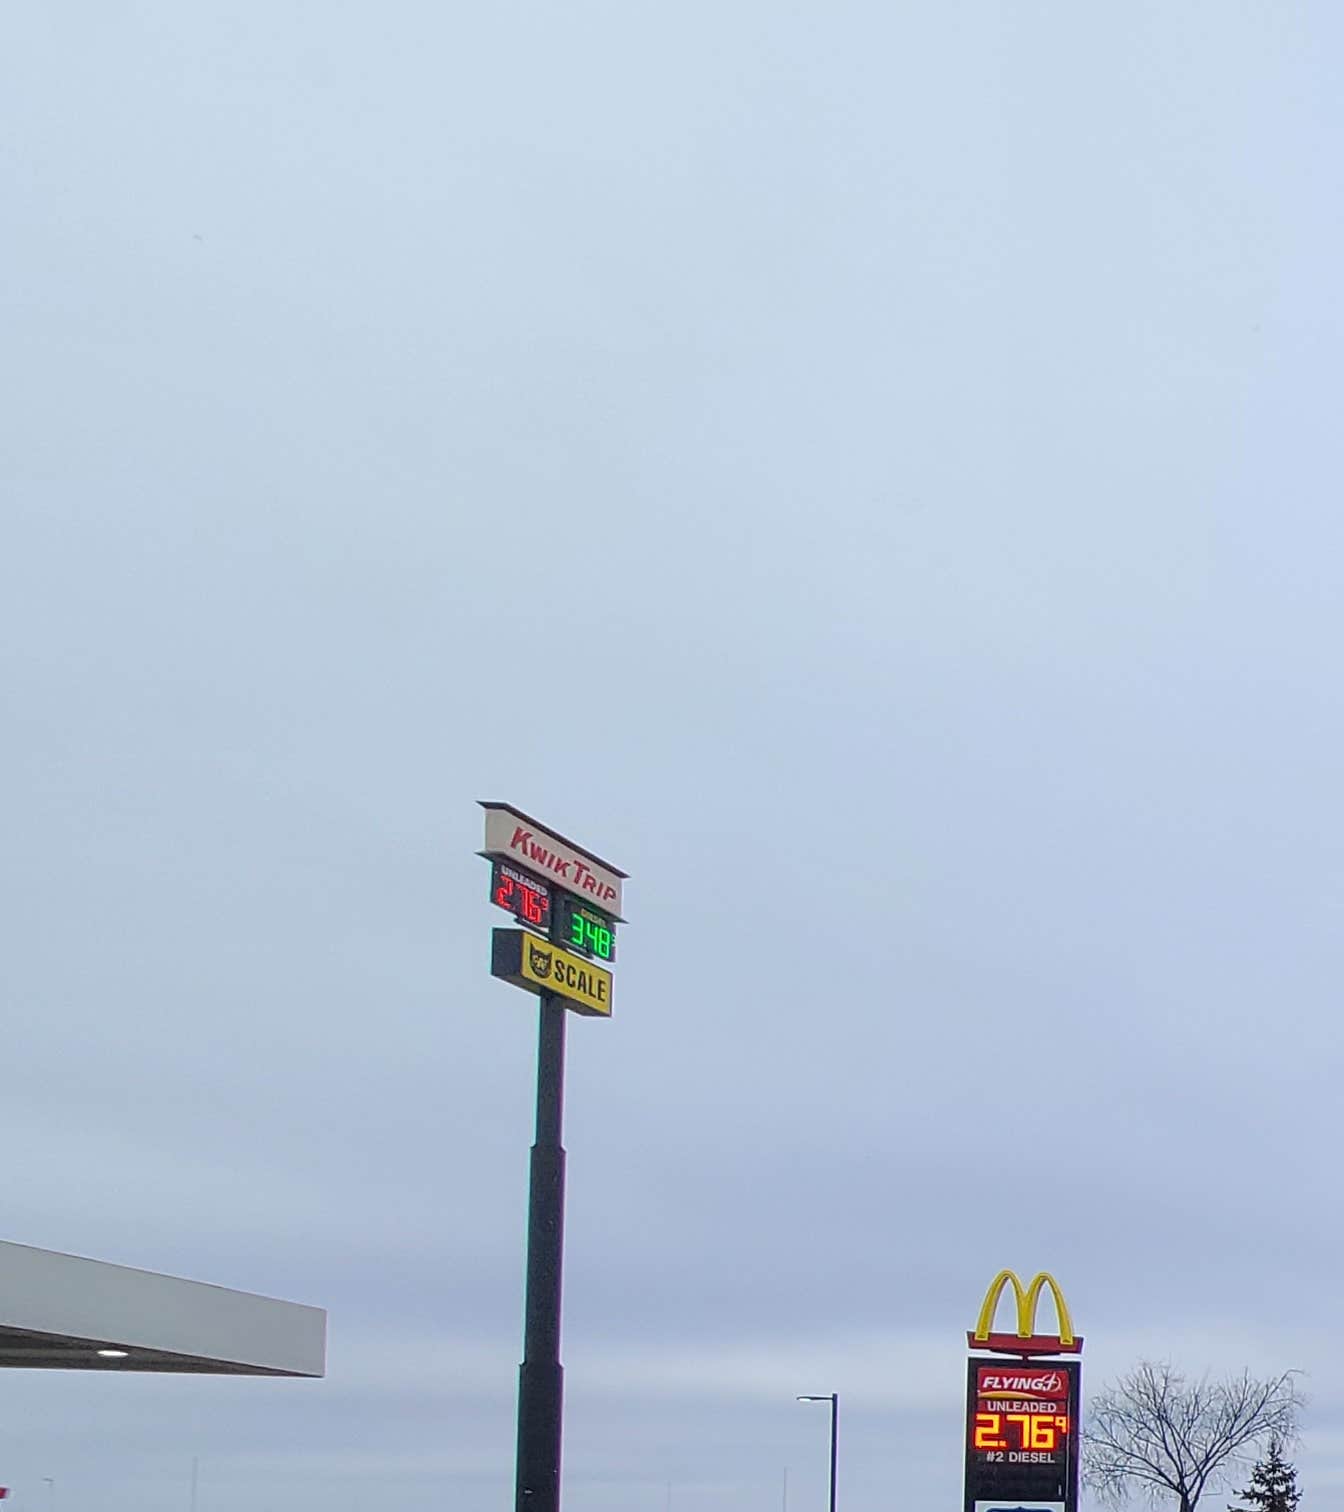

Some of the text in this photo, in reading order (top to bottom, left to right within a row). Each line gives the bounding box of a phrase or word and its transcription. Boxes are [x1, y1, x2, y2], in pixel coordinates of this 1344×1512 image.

[510, 826, 617, 901] KWIK TRIP
[554, 959, 606, 1002] SCALE
[982, 1376, 1042, 1391] FLYING
[987, 1400, 1057, 1413] UNLEADED
[986, 1451, 1056, 1464] #2 DIESEL
